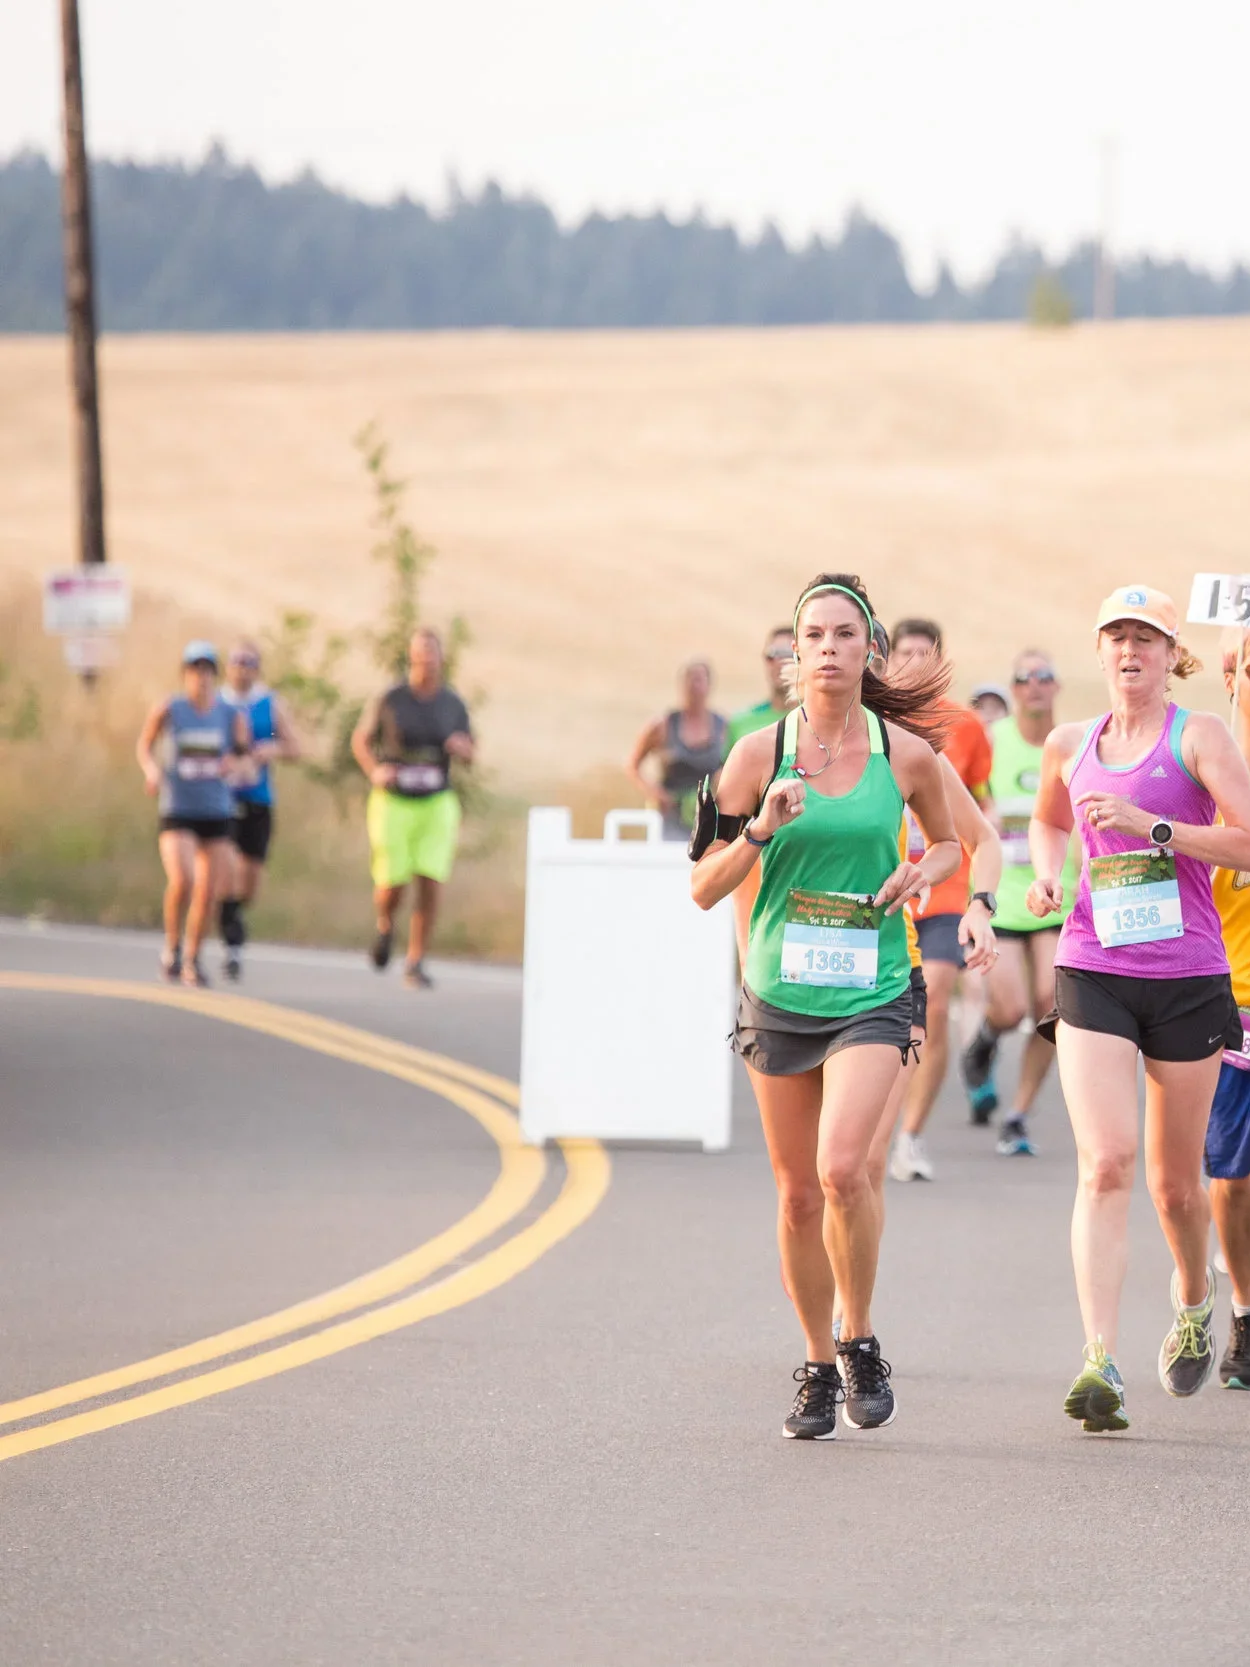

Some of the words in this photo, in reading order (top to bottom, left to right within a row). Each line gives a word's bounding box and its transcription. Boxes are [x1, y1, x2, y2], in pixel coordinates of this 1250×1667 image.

[829, 918, 846, 927] 2017
[1112, 905, 1161, 931] 1356
[804, 948, 855, 973] 1365
